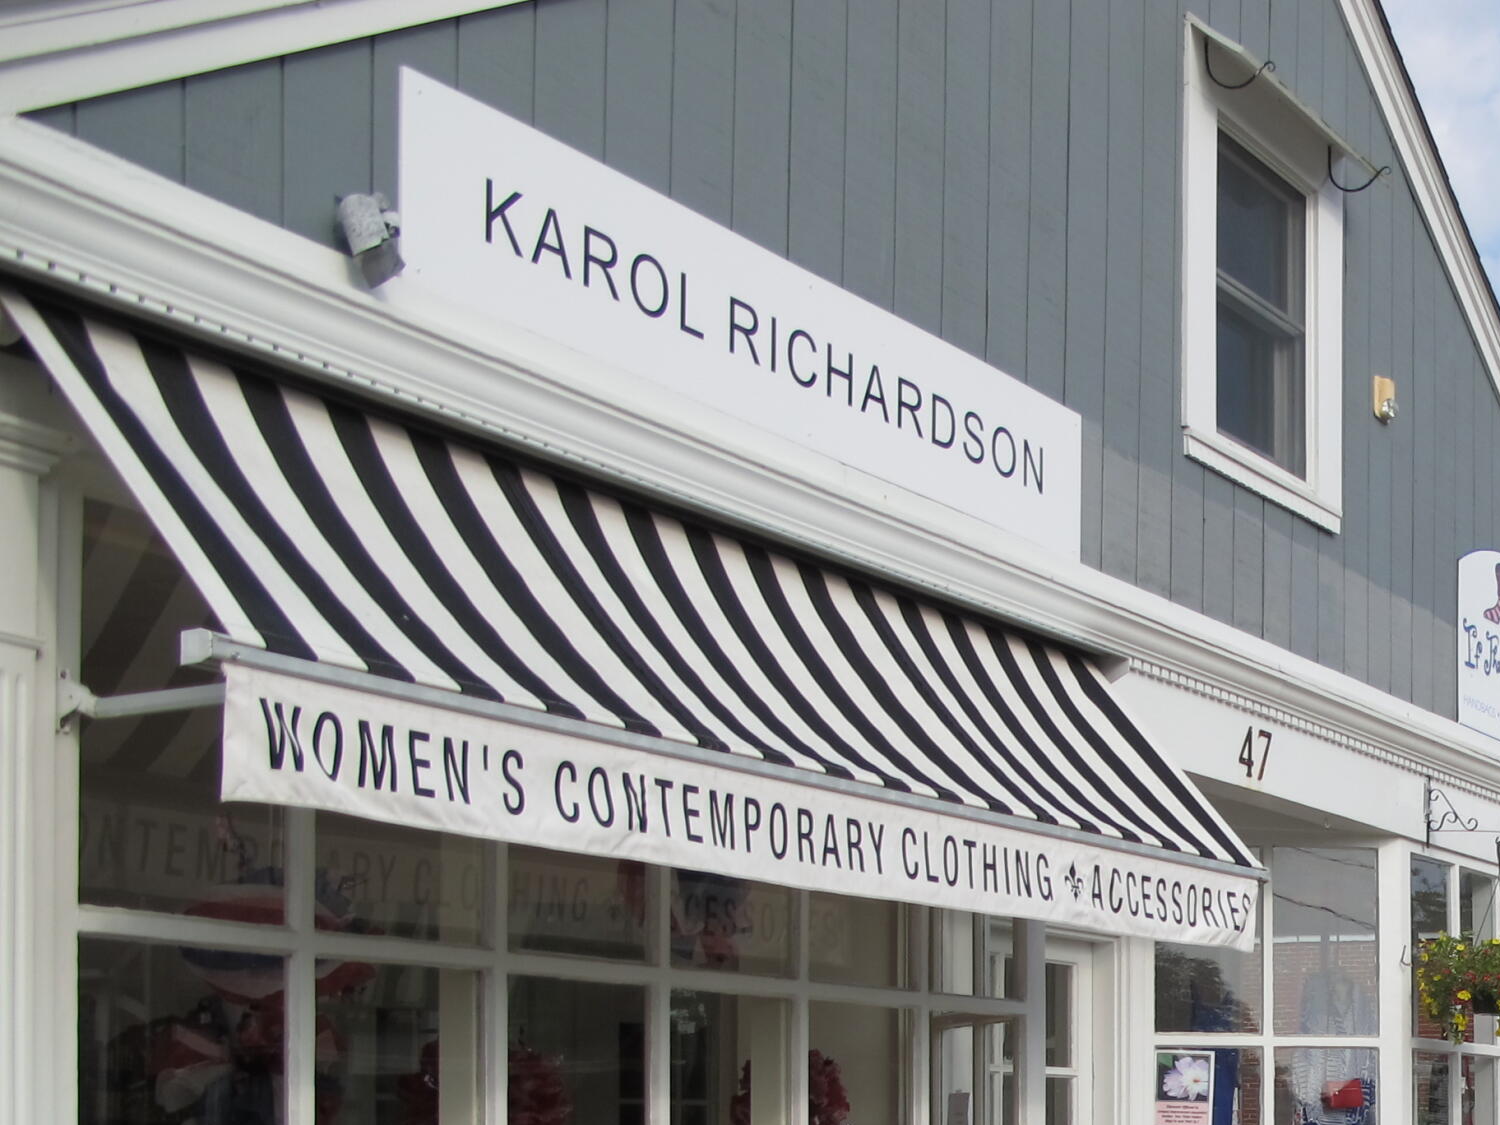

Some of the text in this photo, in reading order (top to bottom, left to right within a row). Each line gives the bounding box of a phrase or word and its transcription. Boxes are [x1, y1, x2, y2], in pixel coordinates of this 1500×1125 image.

[485, 178, 1045, 494] KAROL RICHARDSON
[1463, 618, 1483, 669] If
[260, 698, 1256, 933] WOMEN'S CONTEMPORARY CLOTHING ACCESSORIES
[1238, 726, 1272, 781] 47
